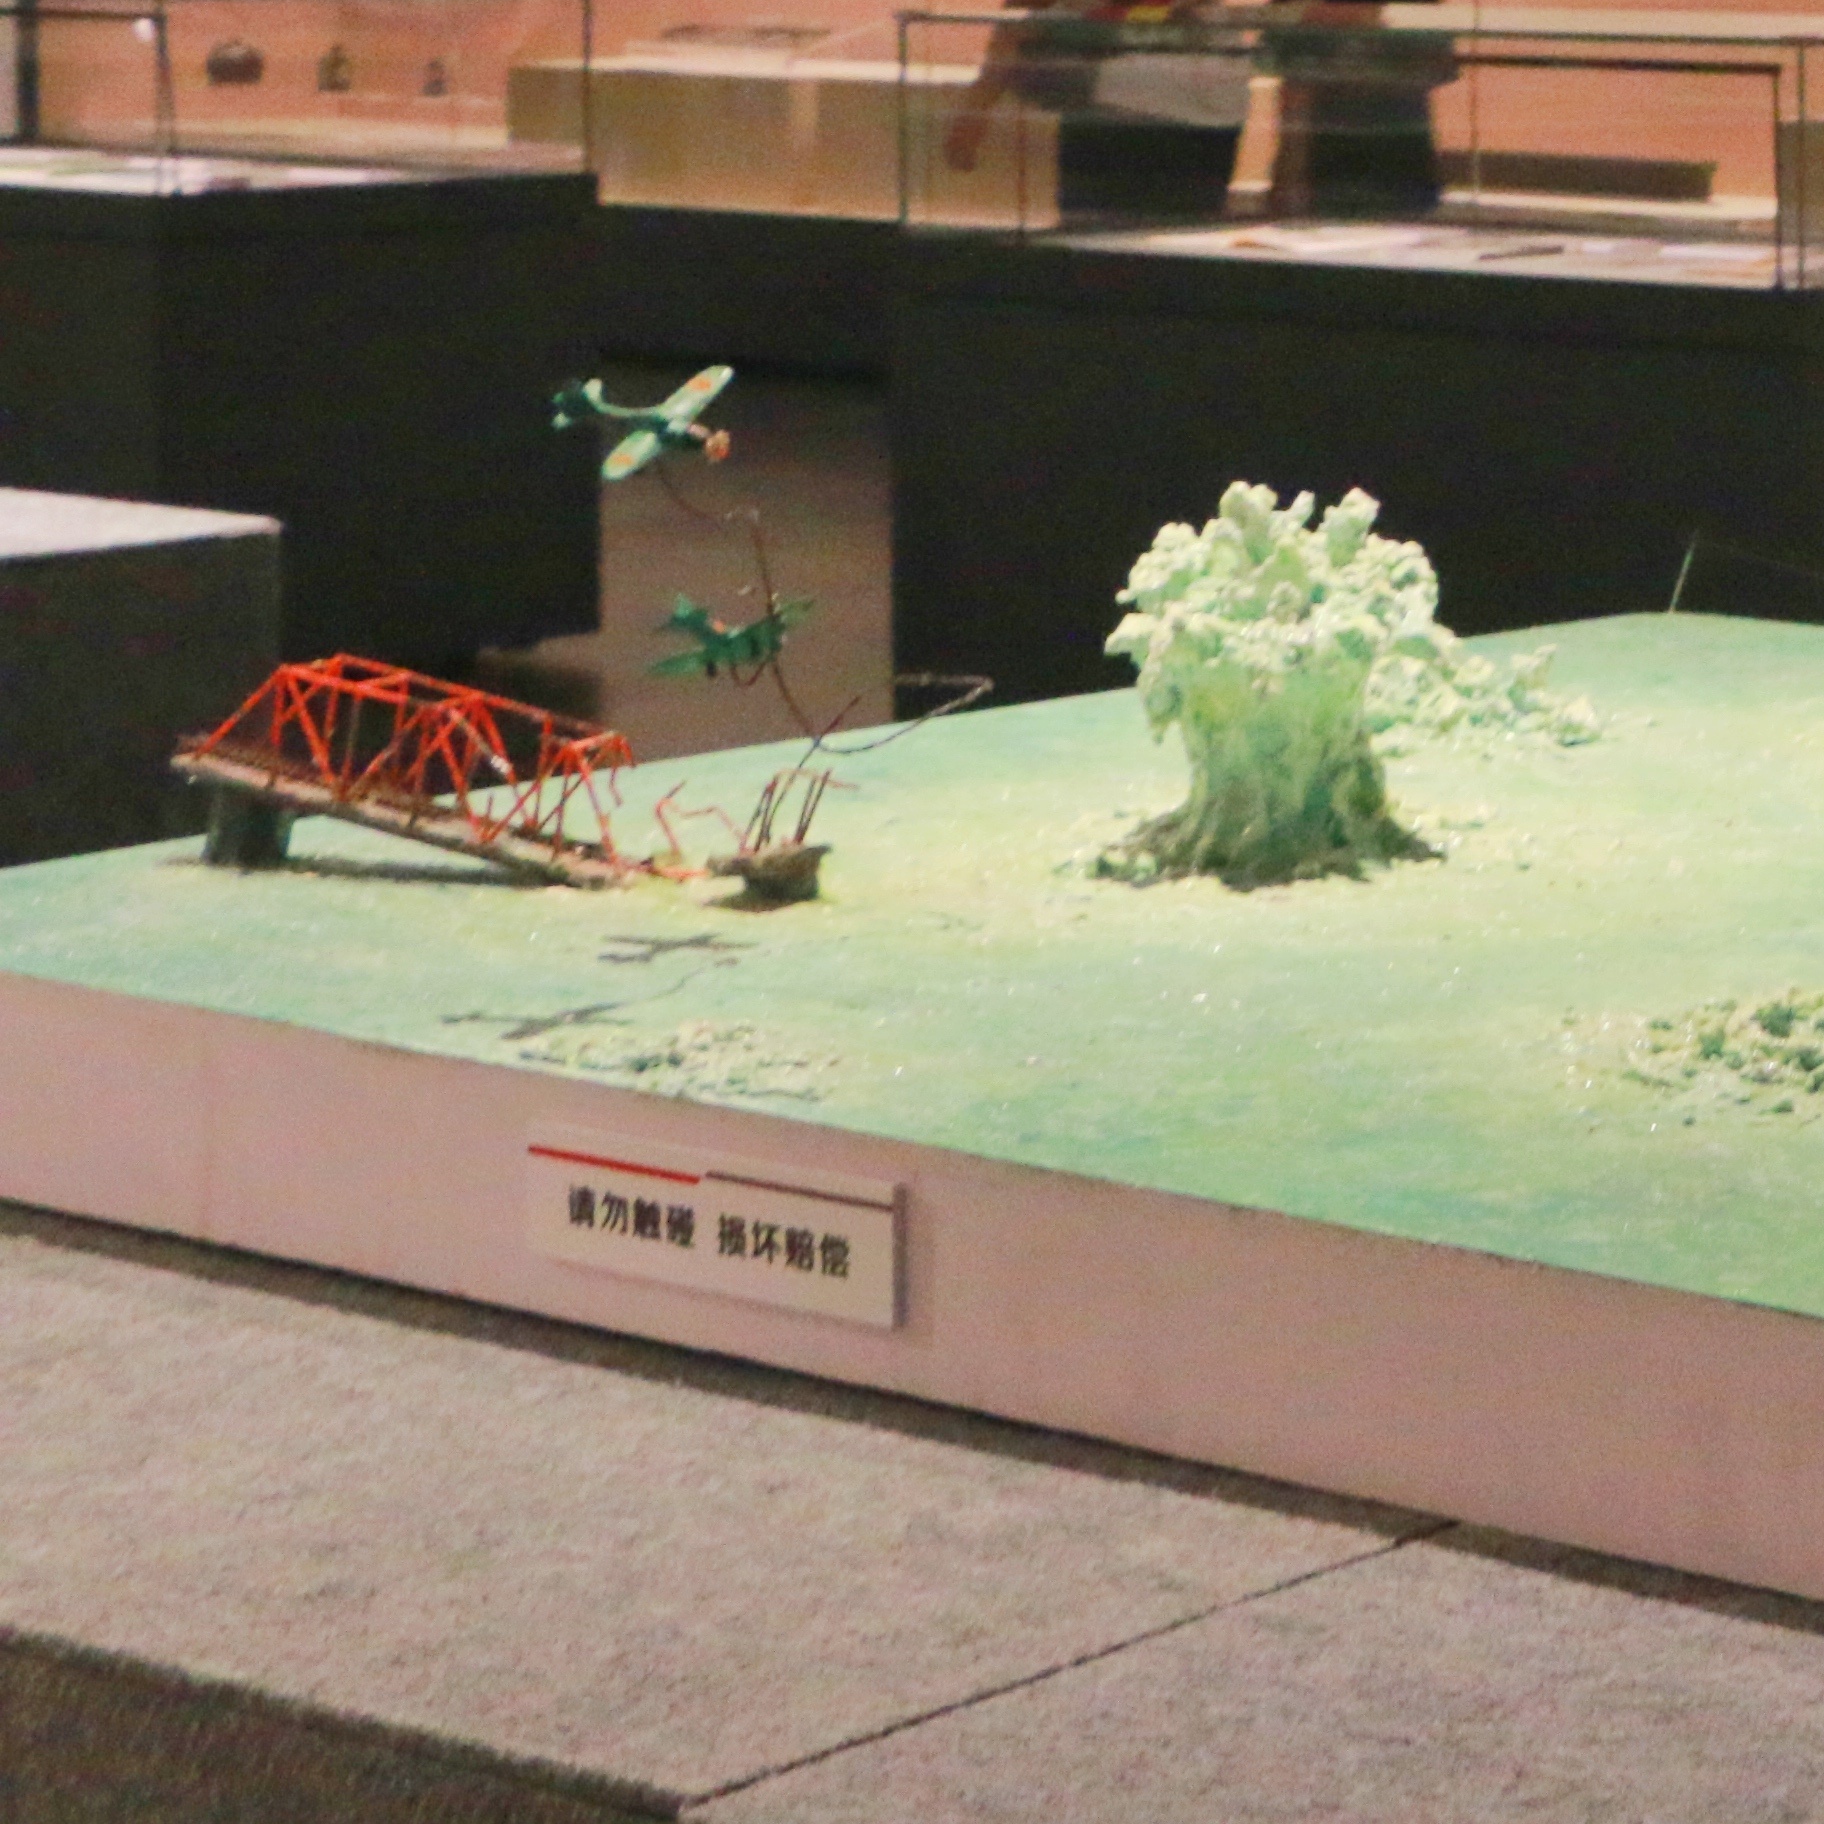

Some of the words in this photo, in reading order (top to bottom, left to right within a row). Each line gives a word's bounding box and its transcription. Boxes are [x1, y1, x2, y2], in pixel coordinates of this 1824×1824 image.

[568, 1183, 696, 1249] 请勿触碰
[718, 1212, 850, 1278] 损坏赔偿
